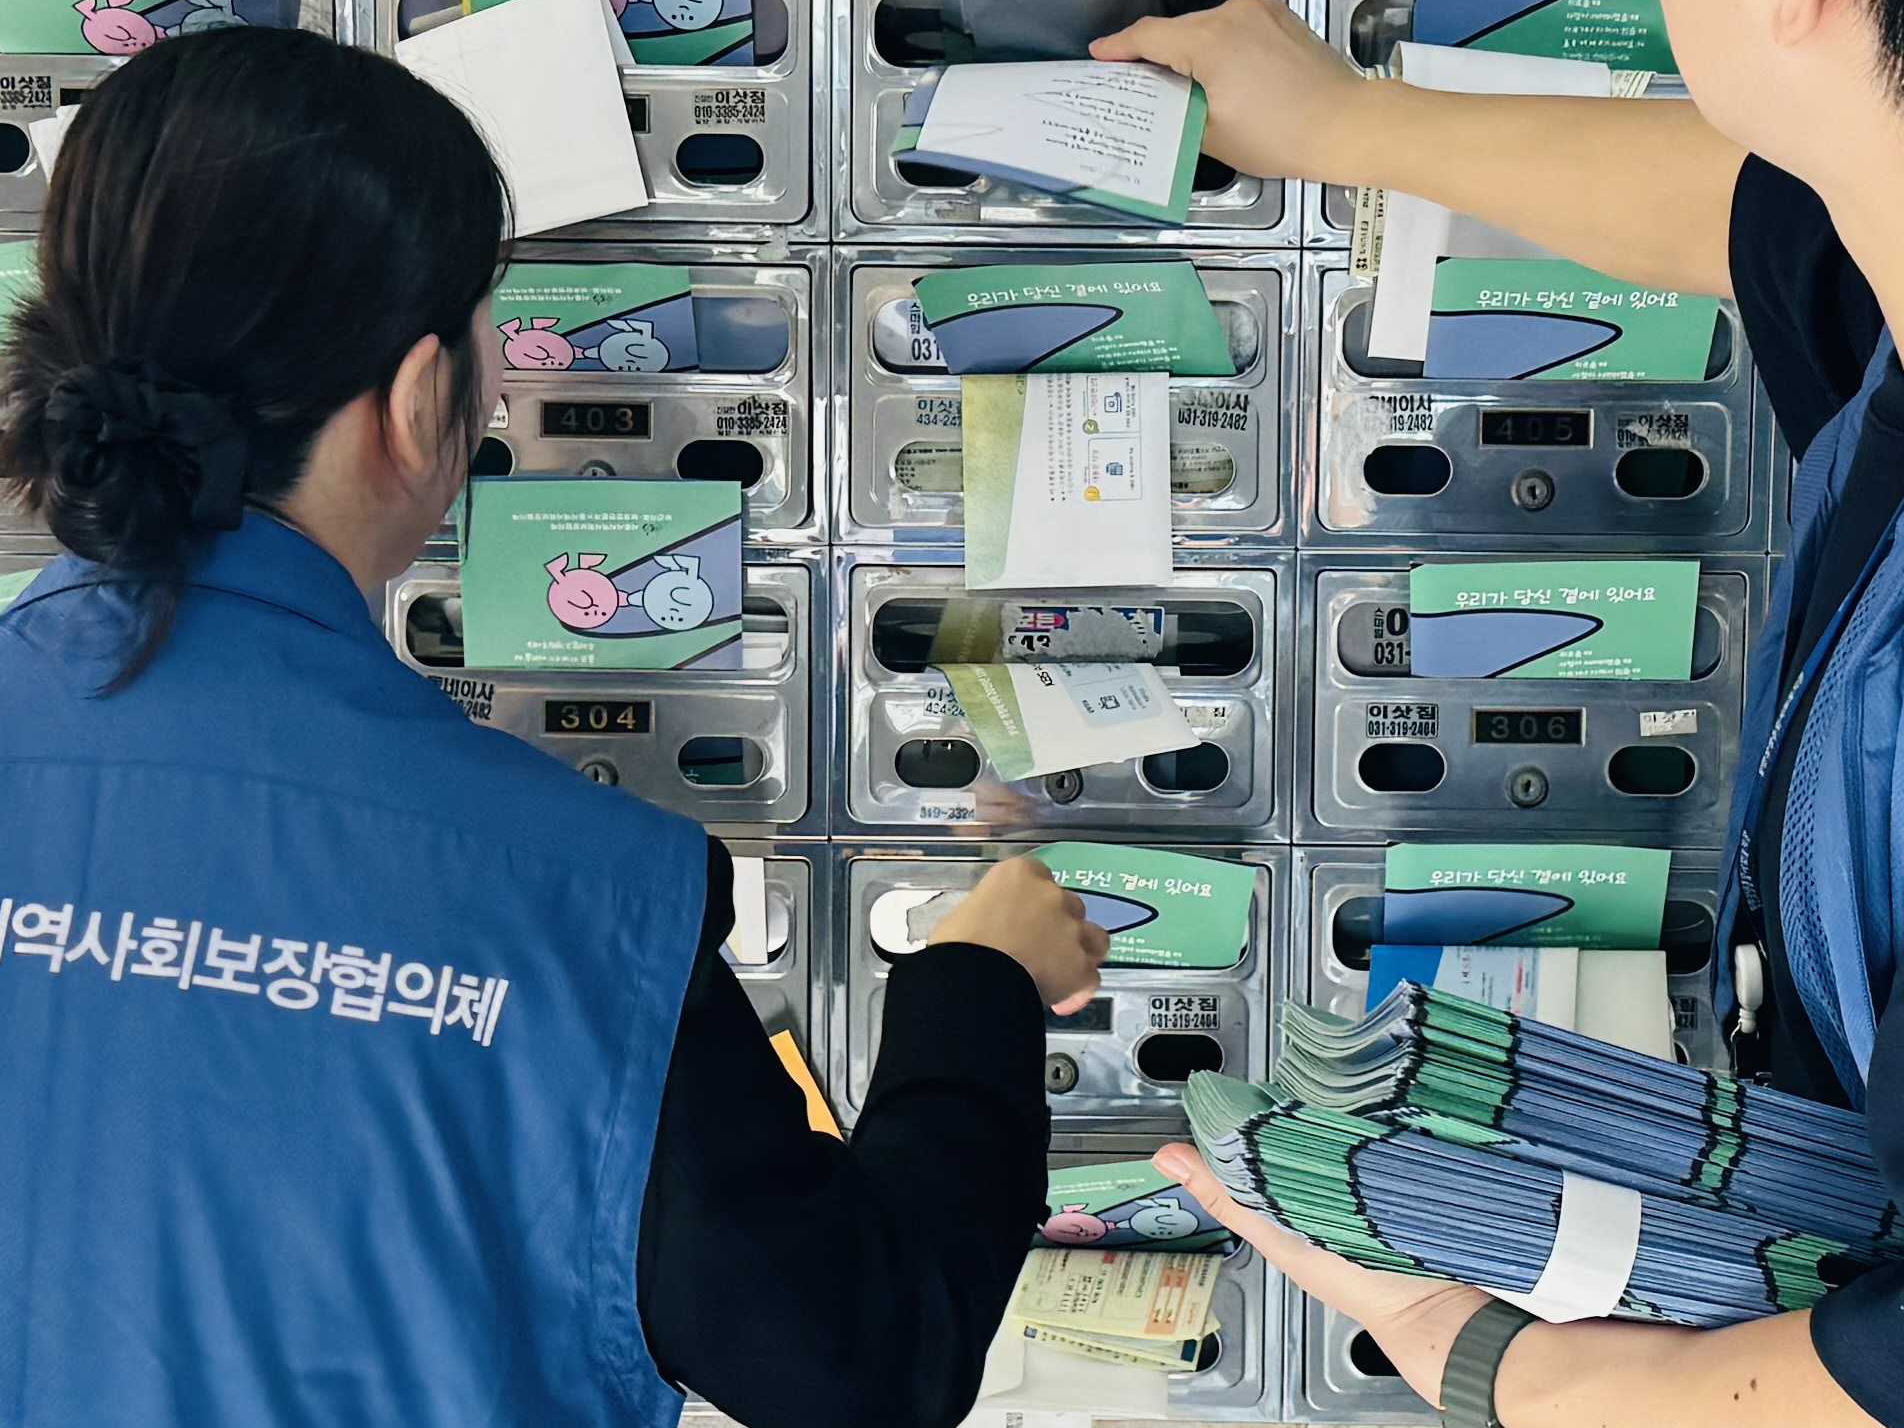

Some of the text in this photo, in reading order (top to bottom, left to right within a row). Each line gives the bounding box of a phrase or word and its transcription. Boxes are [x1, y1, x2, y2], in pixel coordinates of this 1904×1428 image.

[715, 90, 765, 104] 이삿짐
[967, 288, 1019, 308] 우리가
[1022, 283, 1062, 300] 당신
[1113, 281, 1166, 294] 있어요
[1476, 289, 1679, 310] 우리가 당신 곁에 있어요
[560, 406, 634, 432] 403
[1496, 416, 1573, 442] 405
[1455, 586, 1656, 608] 우리가 당신 곁에 있어요
[560, 705, 637, 730] 304
[1369, 705, 1436, 720] 이삿짐
[1490, 715, 1568, 740] 306
[1074, 870, 1112, 888] 당신
[1119, 873, 1158, 891] 곁에
[1164, 878, 1213, 898] 있어요
[1429, 870, 1481, 886] 우리가
[1487, 869, 1525, 885] 당신
[1577, 870, 1627, 886] 있어요
[1151, 997, 1218, 1012] 이삿짐
